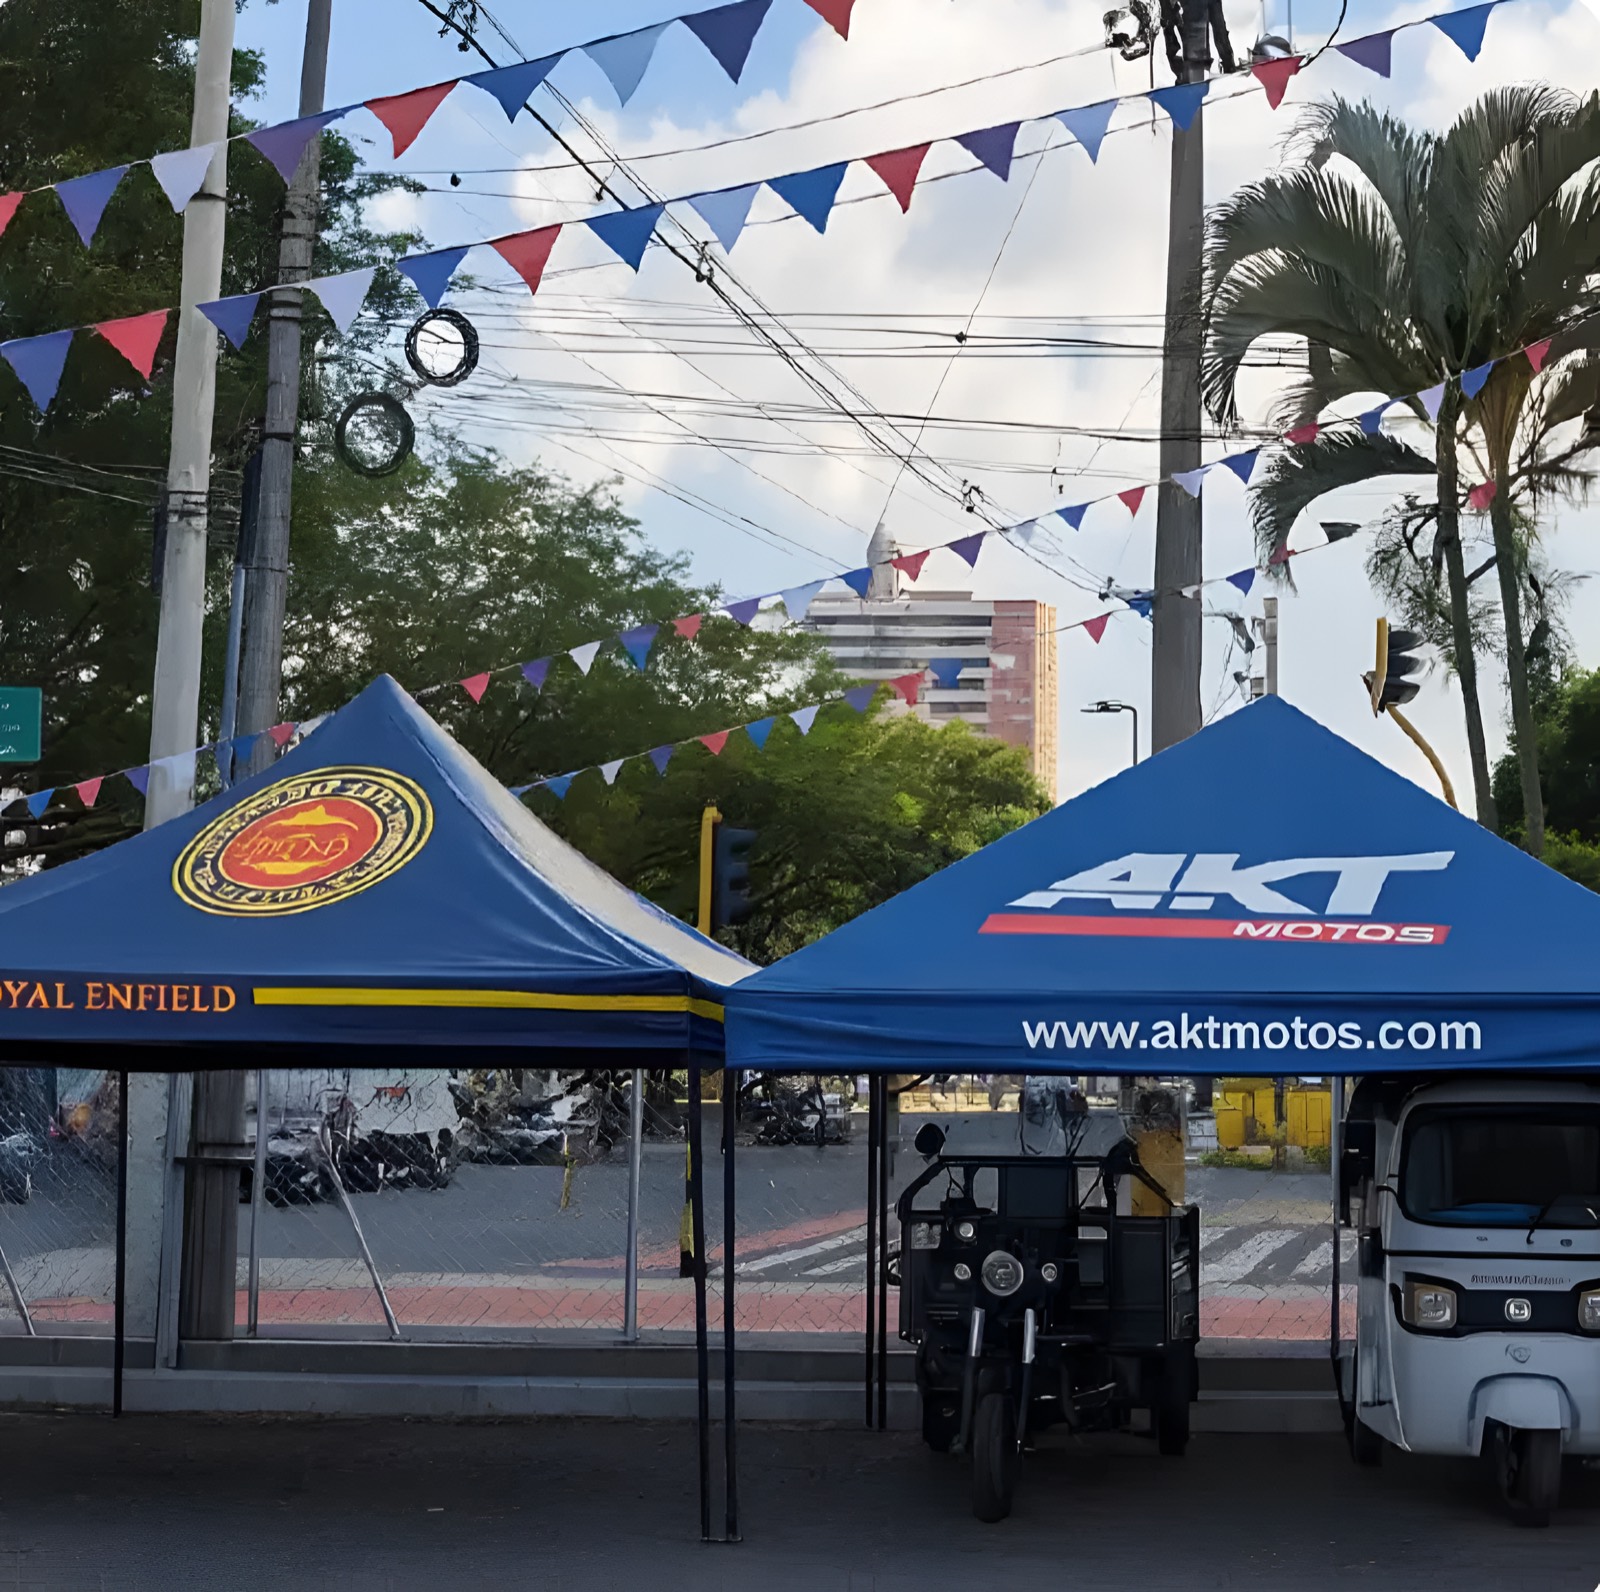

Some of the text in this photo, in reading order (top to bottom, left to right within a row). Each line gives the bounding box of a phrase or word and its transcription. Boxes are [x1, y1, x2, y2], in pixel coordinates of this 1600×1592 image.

[1005, 851, 1455, 915] AKT
[1233, 921, 1435, 943] MOTOS
[0, 980, 237, 1013] YAL ENFIELD
[1022, 1012, 1483, 1050] www.aktmotos.com
